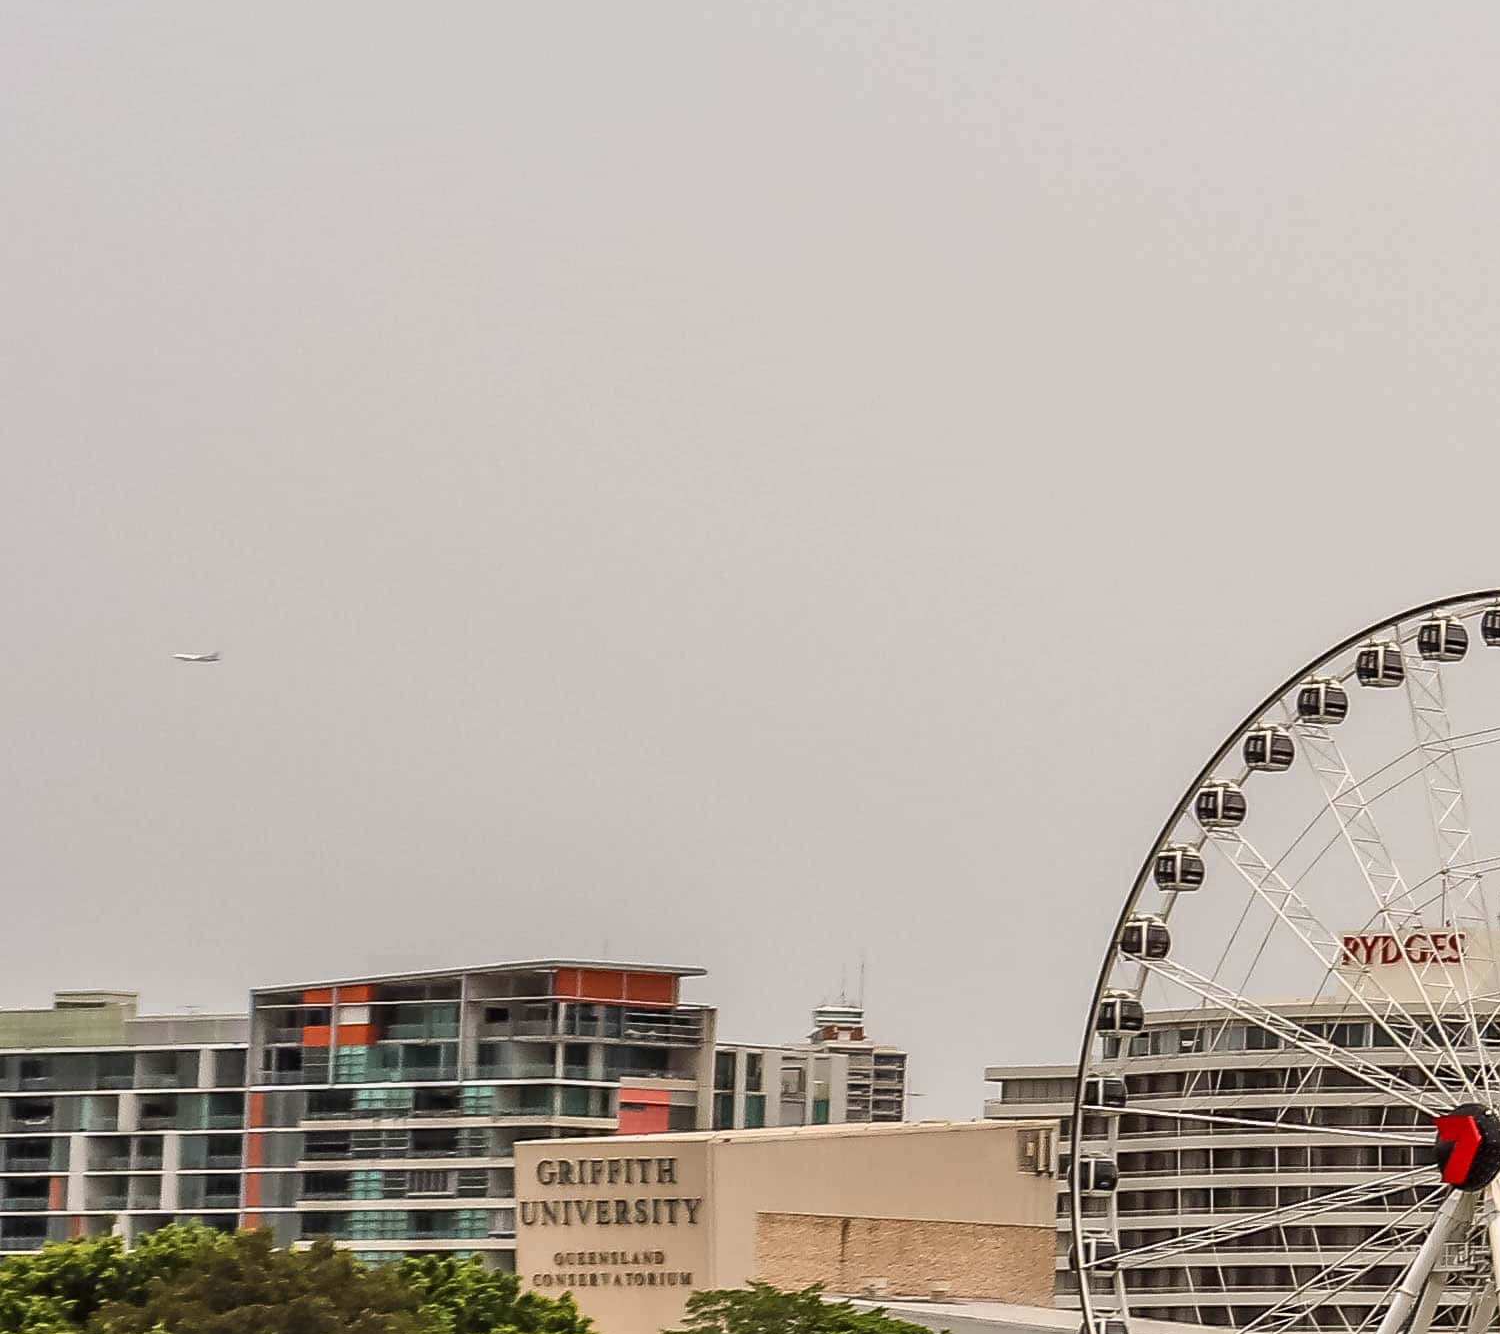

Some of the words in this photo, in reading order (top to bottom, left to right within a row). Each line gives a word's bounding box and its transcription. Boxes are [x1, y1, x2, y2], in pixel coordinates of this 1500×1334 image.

[1342, 933, 1466, 966] RYDGES
[536, 1157, 678, 1186] GRIFFITH
[520, 1197, 702, 1227] UNIVERSITY
[553, 1250, 666, 1267] QUEENSLAND
[532, 1271, 695, 1287] CONSERVATORIUM
